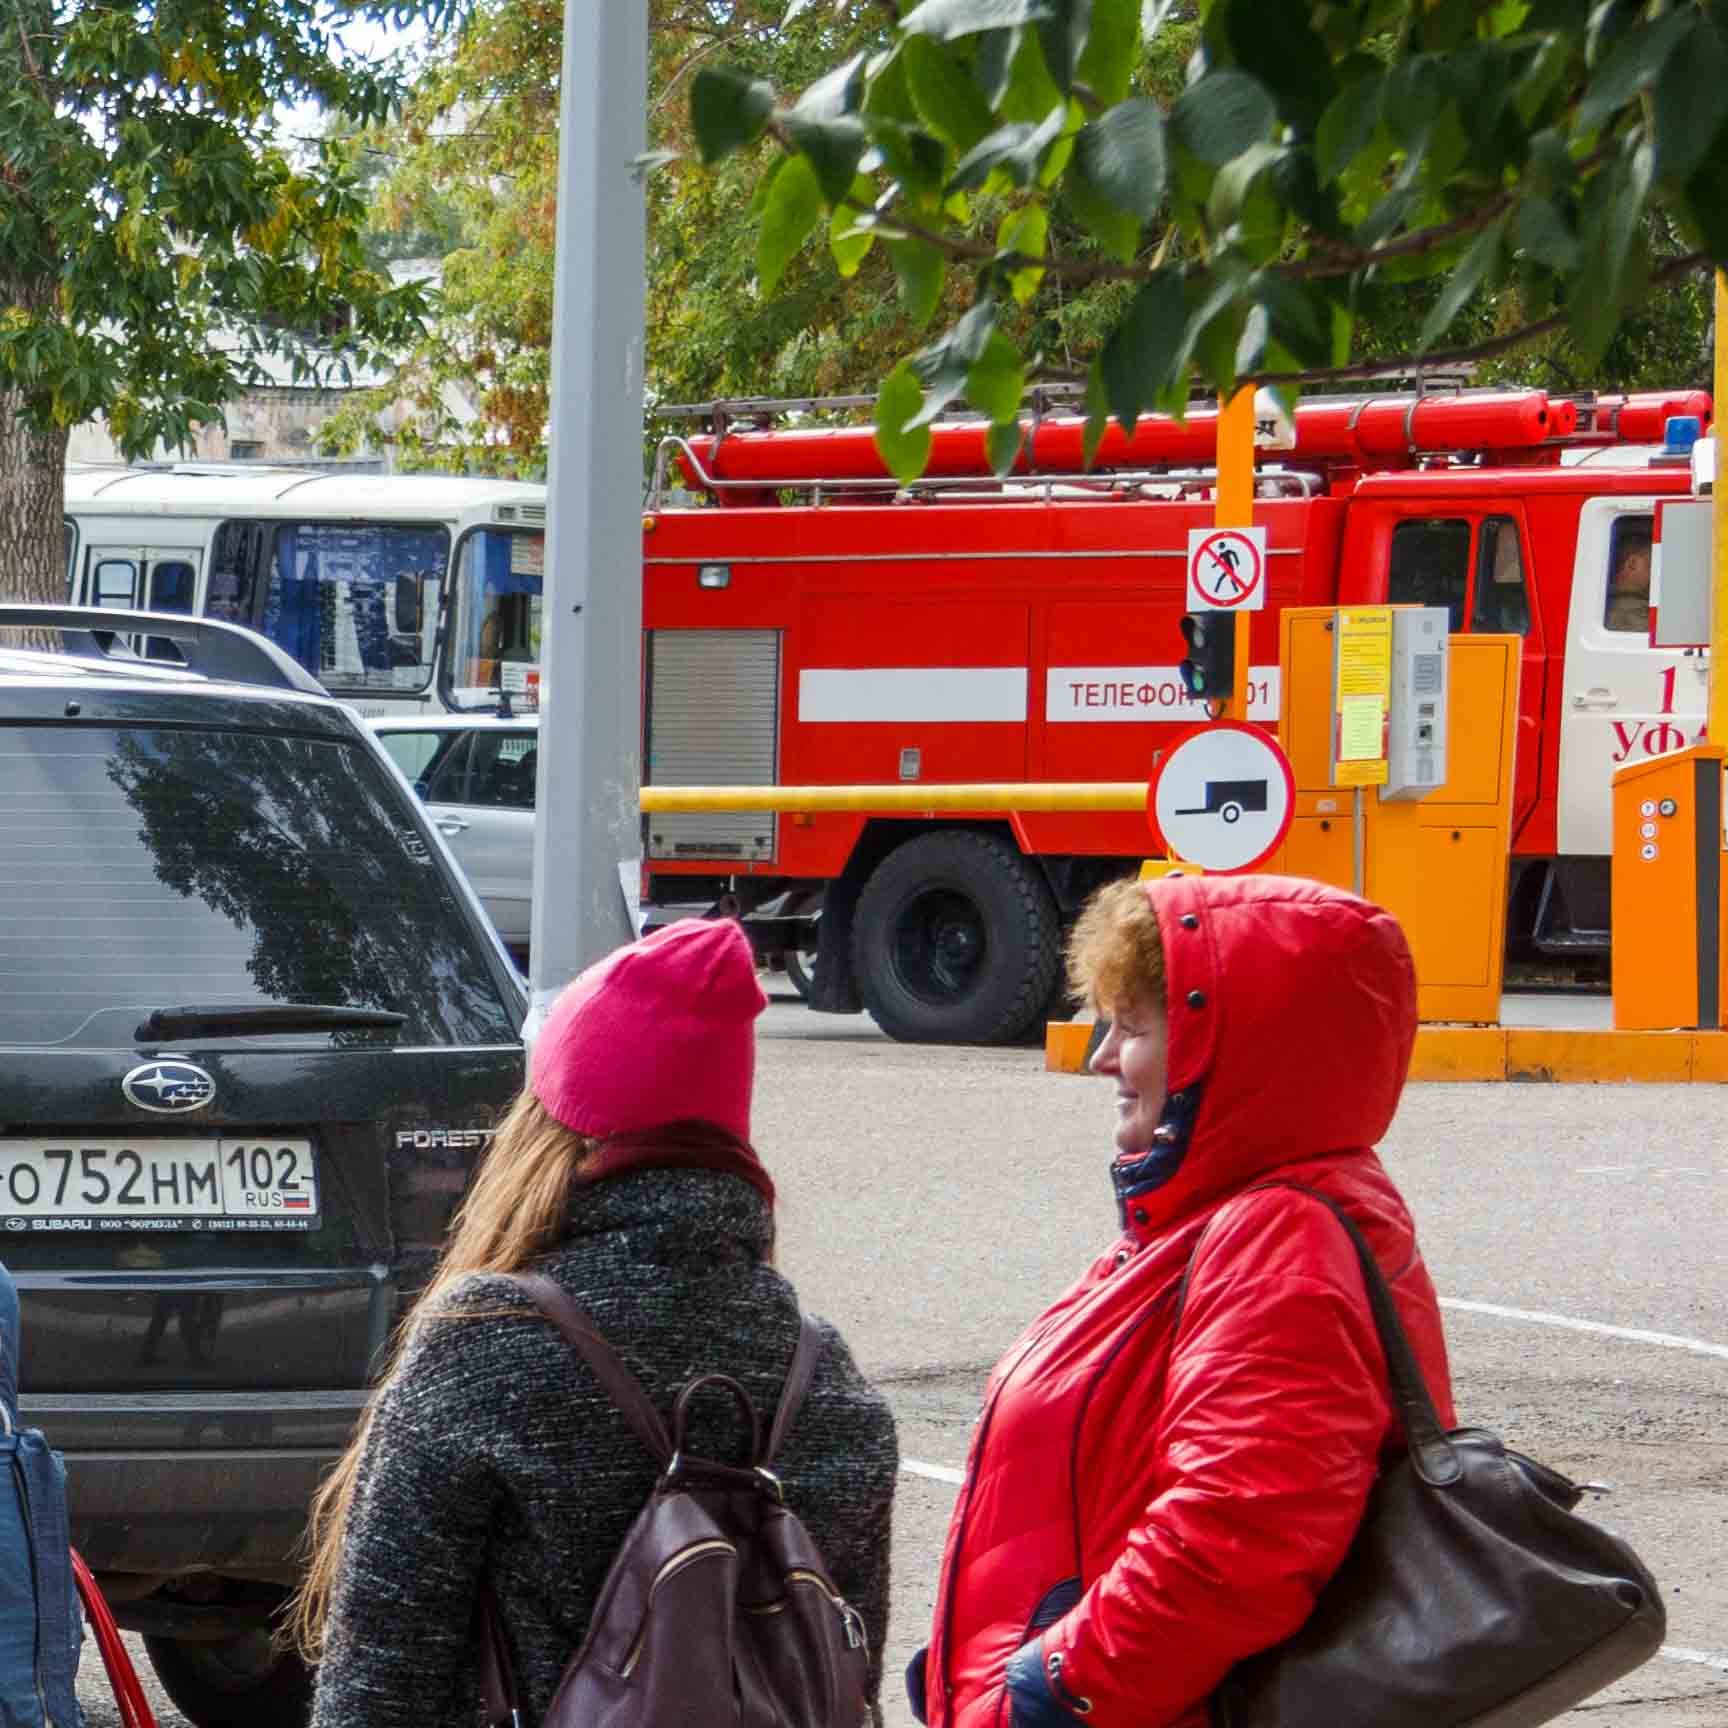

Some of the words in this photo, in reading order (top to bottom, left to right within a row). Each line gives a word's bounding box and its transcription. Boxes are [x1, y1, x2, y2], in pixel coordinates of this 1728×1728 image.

[1658, 665, 1677, 714] 1
[226, 1146, 300, 1190] 102
[246, 1191, 282, 1208] RUS
[32, 1219, 92, 1230] SUBARU
